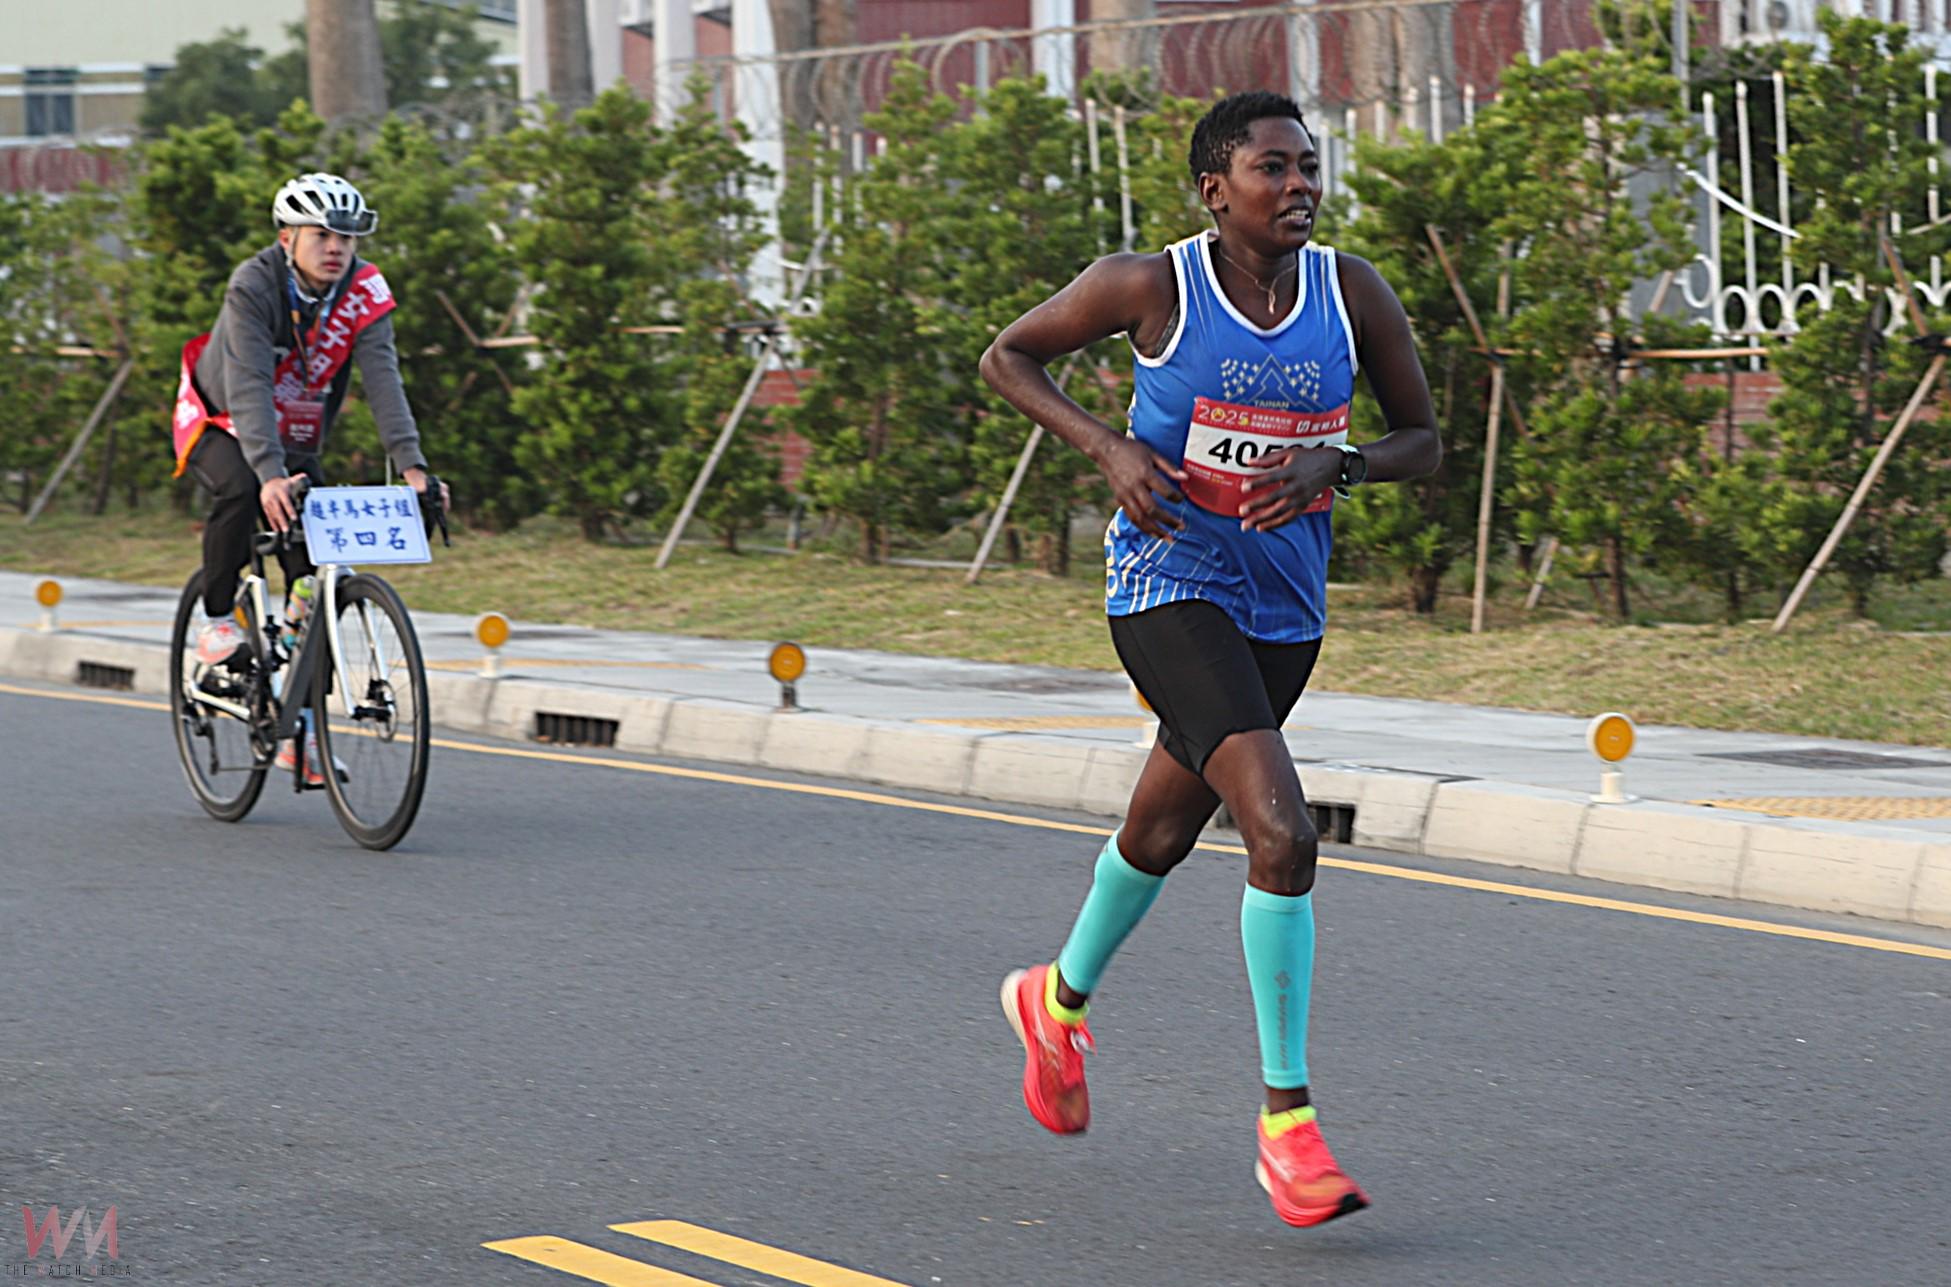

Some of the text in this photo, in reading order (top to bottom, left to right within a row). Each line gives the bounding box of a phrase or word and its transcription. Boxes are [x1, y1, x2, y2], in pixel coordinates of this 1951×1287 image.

[1254, 400, 1289, 409] TAINAN
[325, 526, 407, 553] 第四名
